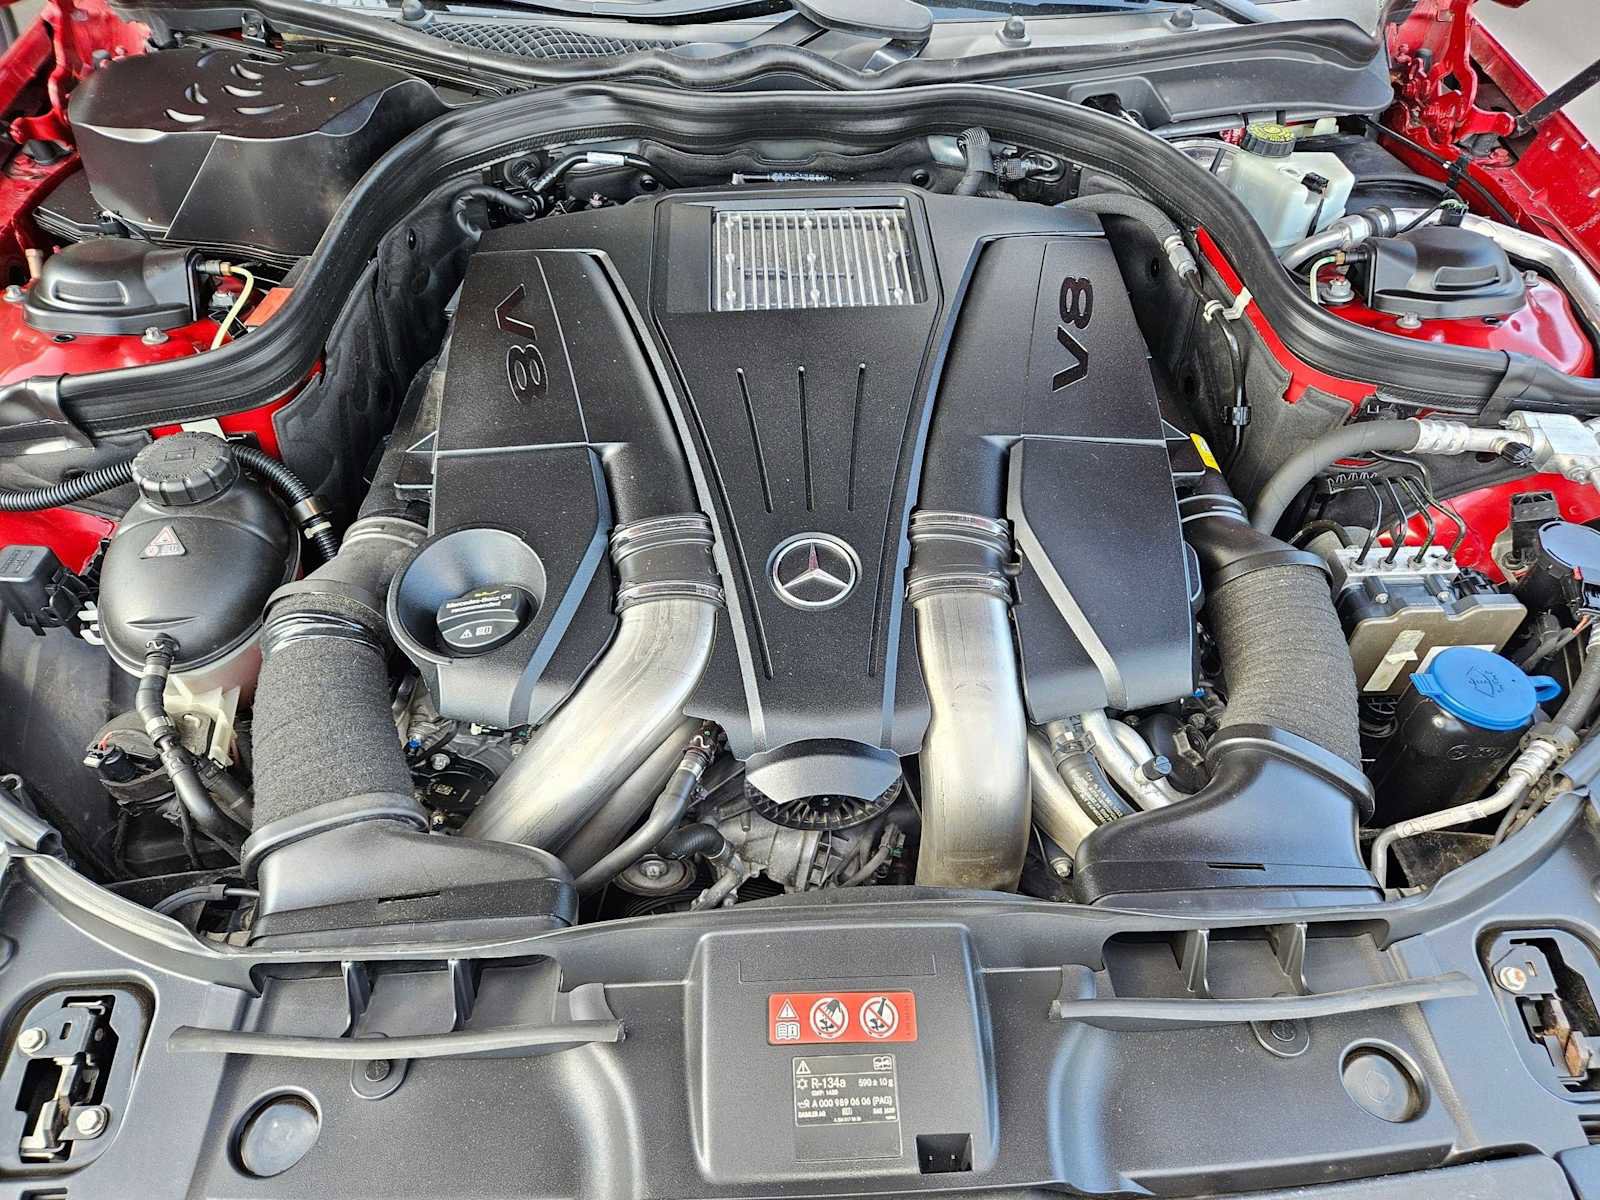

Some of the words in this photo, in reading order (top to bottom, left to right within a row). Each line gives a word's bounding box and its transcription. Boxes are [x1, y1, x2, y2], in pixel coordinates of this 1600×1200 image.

[1052, 276, 1094, 393] V8
[495, 283, 548, 404] V8
[446, 596, 500, 609] Mercedes-Benz
[811, 1077, 846, 1089] R-134a
[858, 1078, 872, 1087] 590
[879, 1078, 887, 1086] 10
[888, 1079, 894, 1087] g
[811, 1099, 818, 1108] A
[819, 1099, 833, 1107] 000
[834, 1098, 849, 1107] 989
[850, 1097, 860, 1106] 06
[861, 1097, 871, 1106] 06
[872, 1095, 893, 1106] (PAG)
